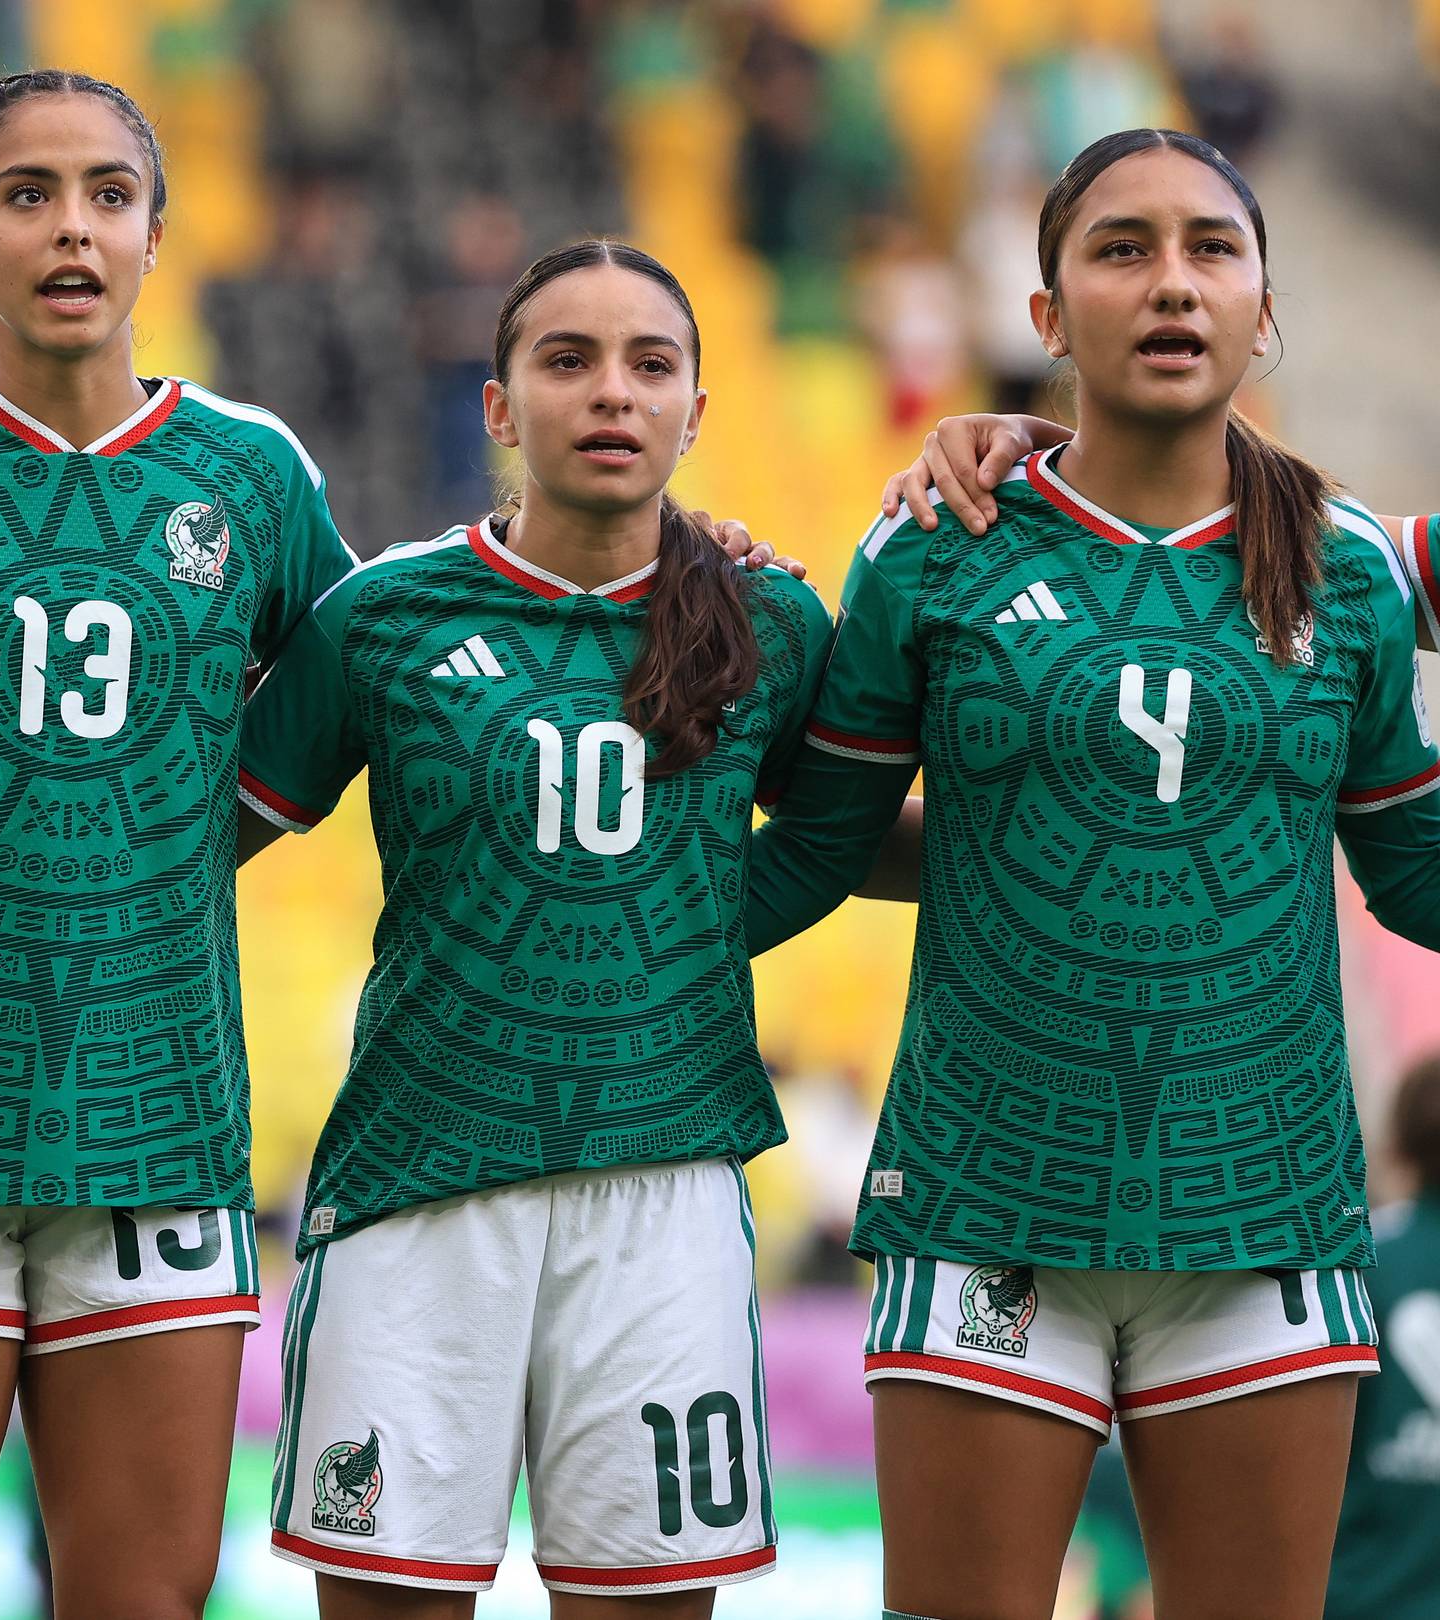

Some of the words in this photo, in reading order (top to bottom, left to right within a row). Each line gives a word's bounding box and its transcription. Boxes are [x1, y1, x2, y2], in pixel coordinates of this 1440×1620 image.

[171, 563, 223, 588] MÉXICO
[13, 595, 134, 740] 13
[1258, 639, 1313, 663] MCO
[1118, 663, 1193, 804] 4
[527, 718, 647, 857] 10
[960, 1329, 1025, 1353] MÉXICO
[641, 1390, 749, 1537] 10
[314, 1511, 371, 1533] MÉXICO
